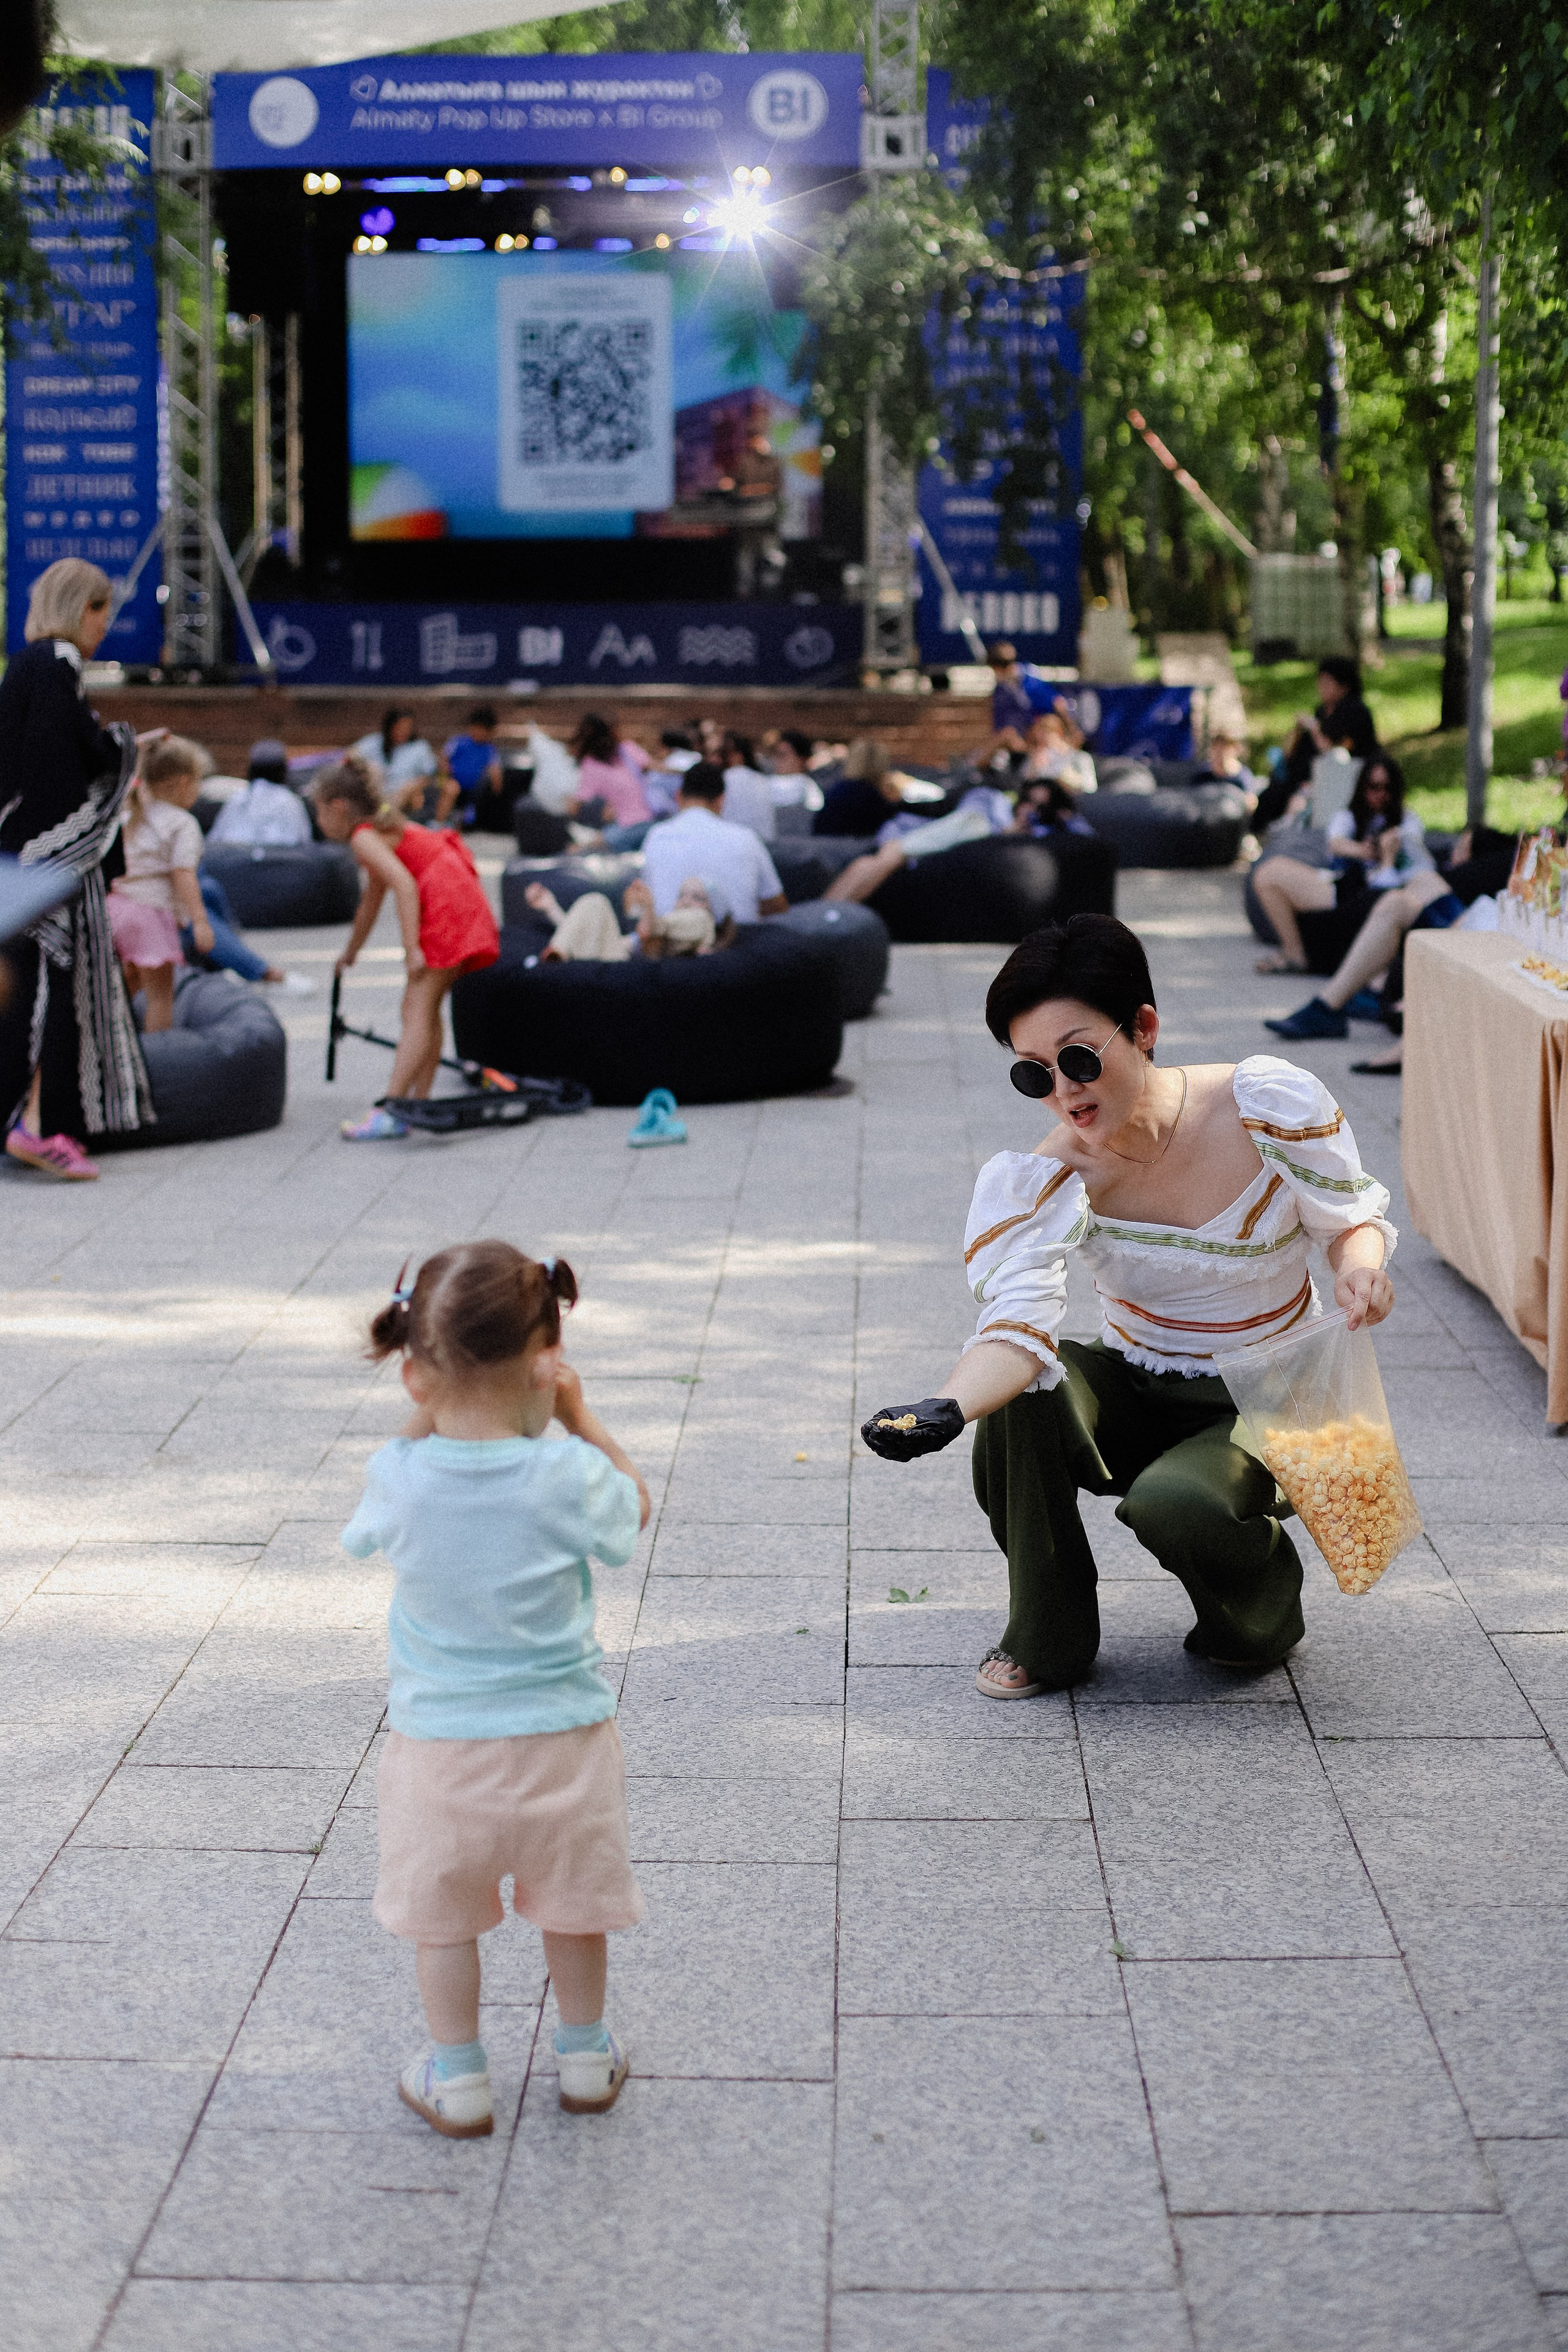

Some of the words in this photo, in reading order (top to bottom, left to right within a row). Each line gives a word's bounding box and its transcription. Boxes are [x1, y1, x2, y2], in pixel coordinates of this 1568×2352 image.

[351, 107, 434, 132] Almaty
[439, 105, 487, 130] Pop
[491, 105, 527, 130] Up
[530, 104, 594, 128] Store
[647, 104, 723, 130] Group
[768, 86, 810, 123] BI
